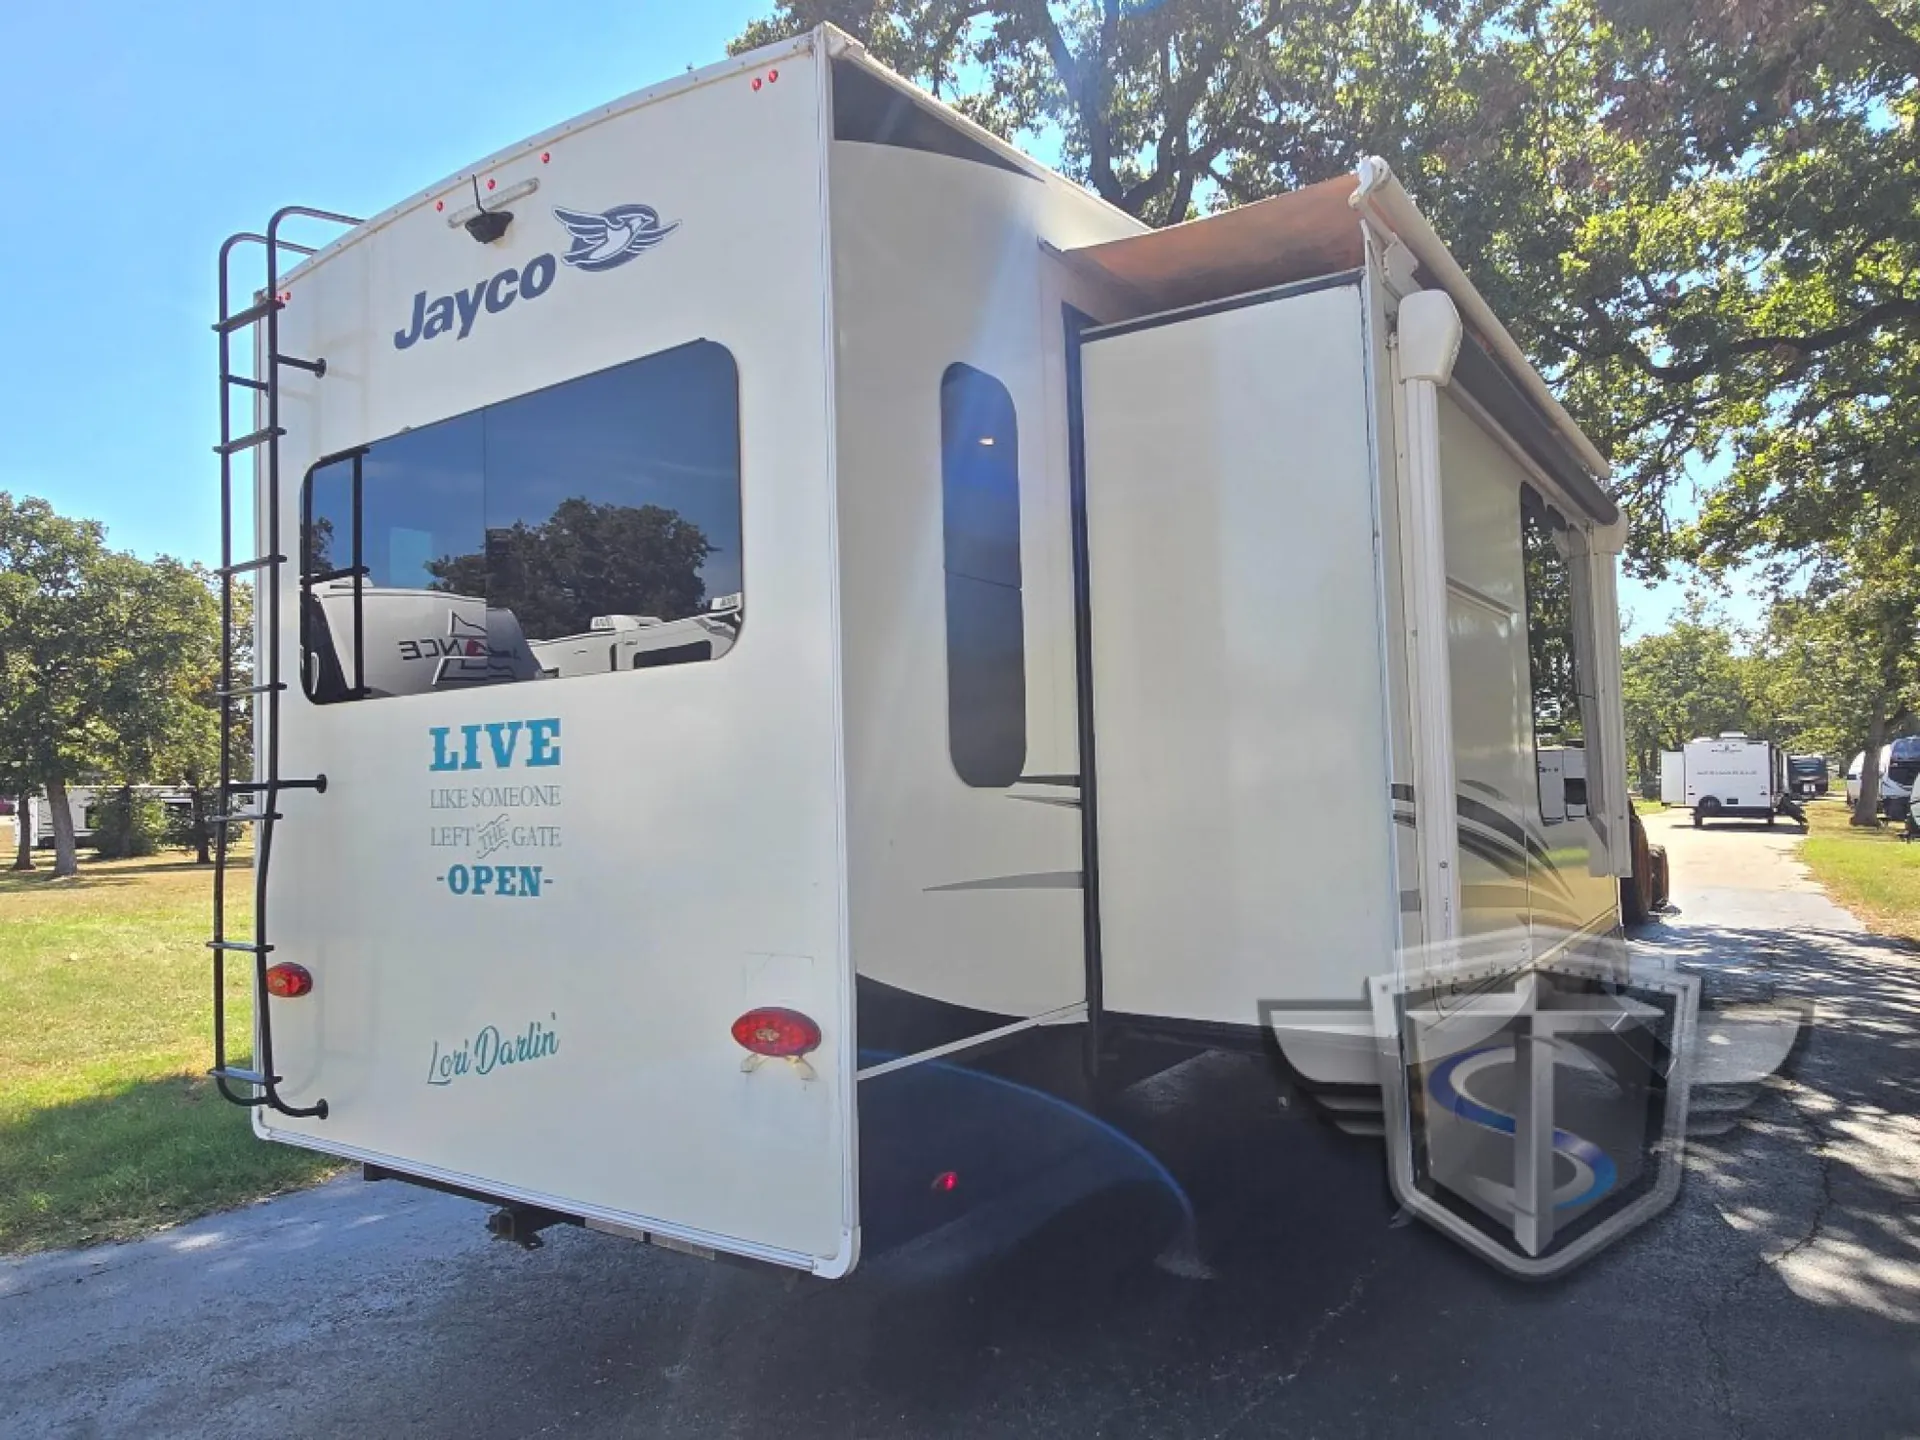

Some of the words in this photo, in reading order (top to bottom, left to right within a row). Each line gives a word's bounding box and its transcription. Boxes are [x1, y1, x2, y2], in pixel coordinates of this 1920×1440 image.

[394, 252, 556, 350] Jayco
[429, 718, 560, 772] LIVE
[430, 788, 468, 809] LIKE
[472, 785, 561, 808] SOMEONE
[430, 827, 473, 846] LEFT
[478, 822, 508, 850] THE
[512, 826, 561, 847] GATE
[427, 1039, 471, 1085] Lori
